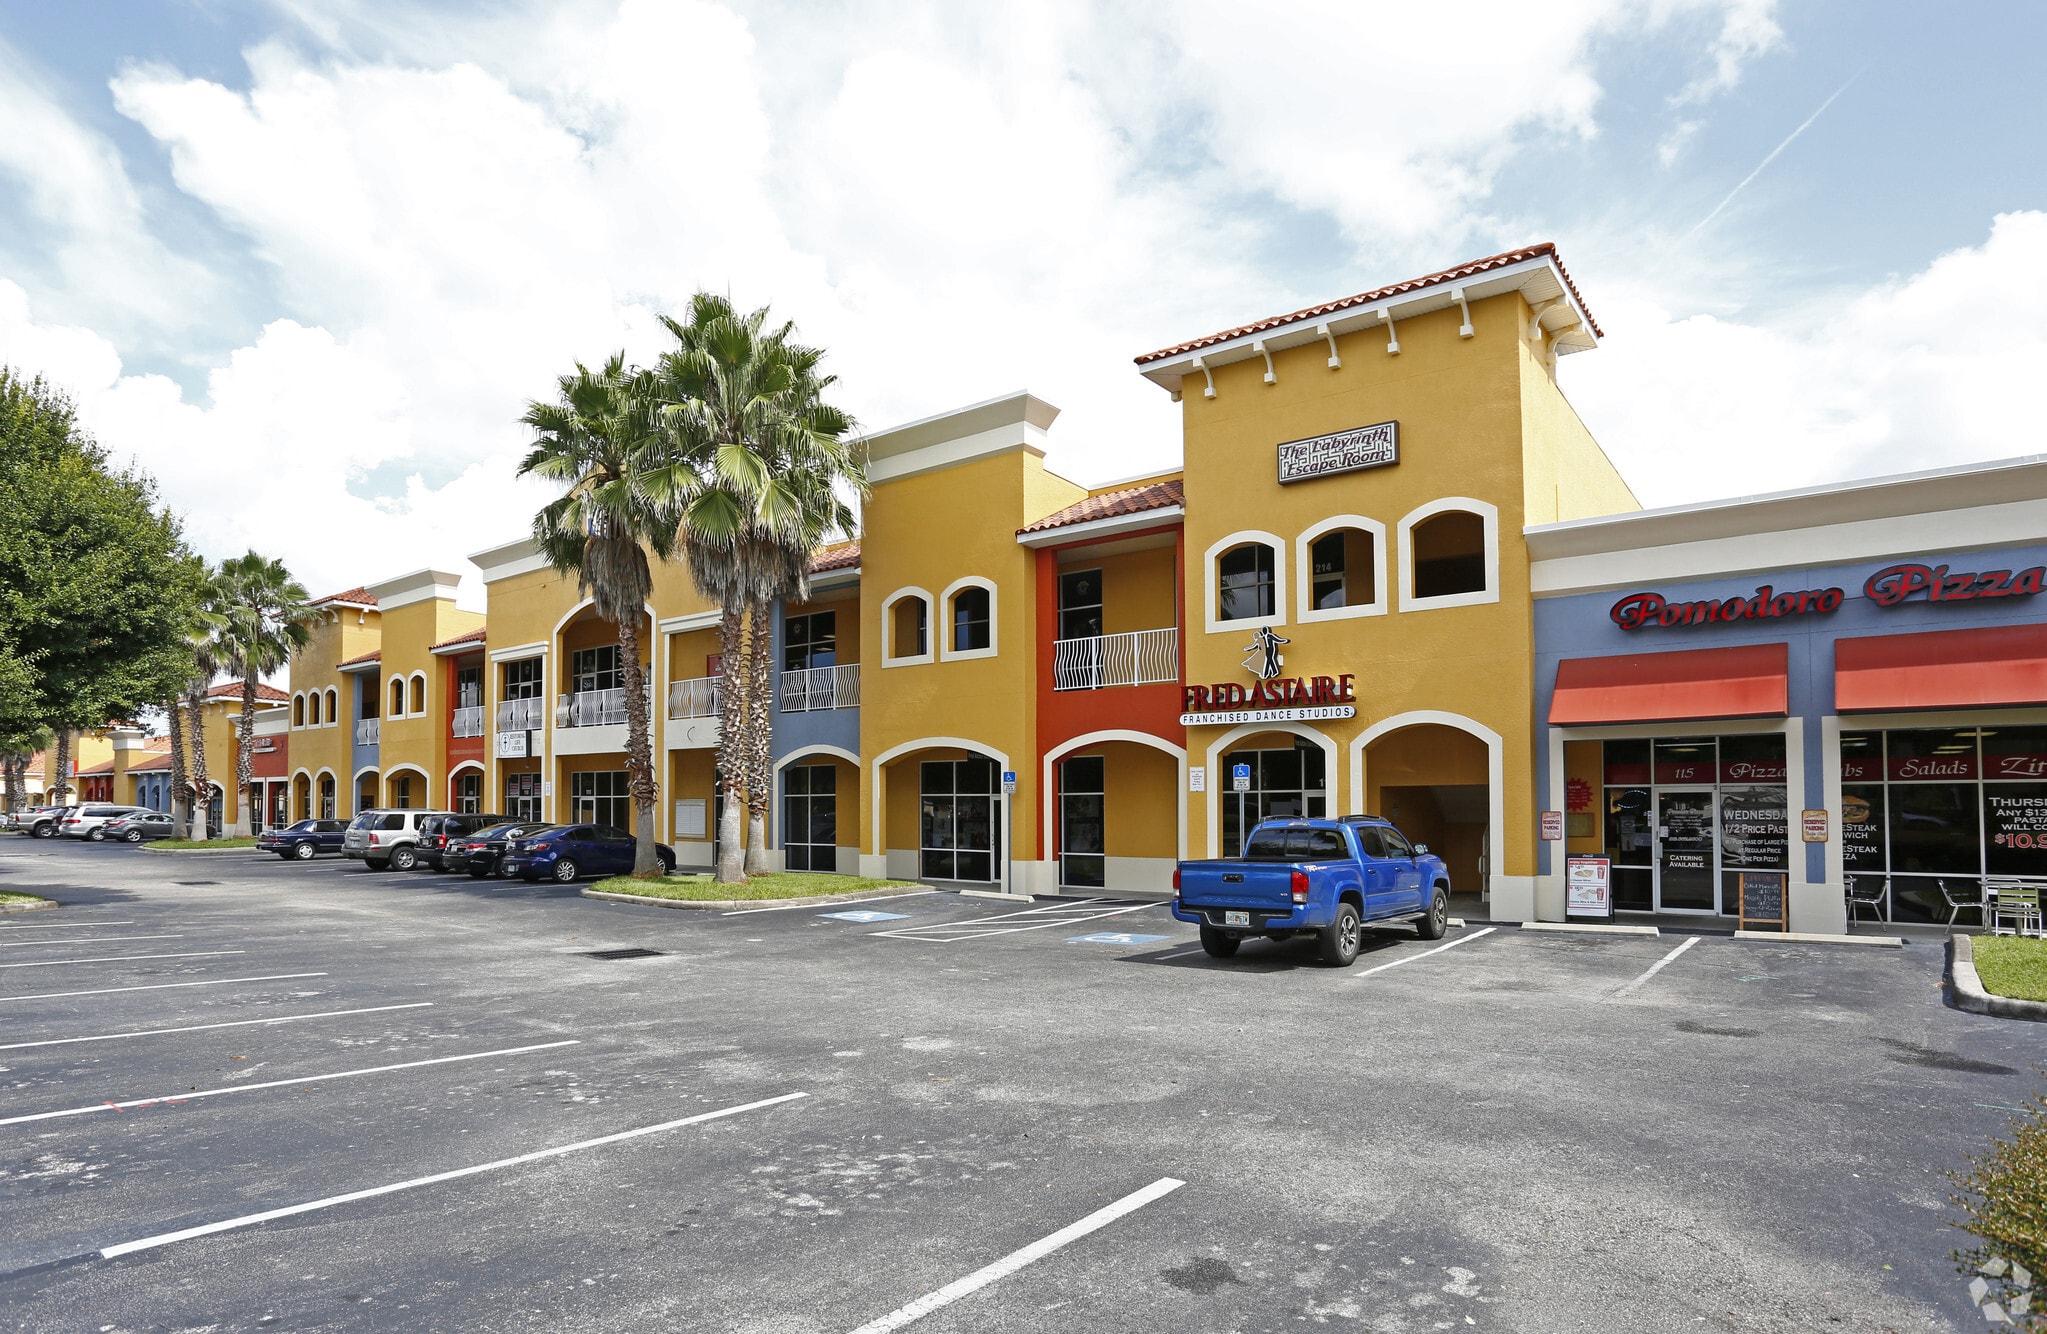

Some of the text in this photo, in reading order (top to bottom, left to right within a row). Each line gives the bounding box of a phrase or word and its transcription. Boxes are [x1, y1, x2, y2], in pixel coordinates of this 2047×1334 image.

[1283, 427, 1389, 460] The Labyrinth
[1286, 450, 1387, 477] Escape Room
[1315, 562, 1331, 573] 214
[1610, 563, 2047, 631] Pomodoro Pizza
[1180, 673, 1357, 713] FRED ASTAIRE
[1183, 712, 1249, 724] FRANCHISED
[1256, 710, 1292, 721] DANCE
[1675, 768, 1694, 778] 115
[1729, 763, 1787, 778] Pizza
[1841, 763, 1863, 777] bs
[1899, 759, 1968, 777] Salads
[1725, 824, 1740, 834] 1/2
